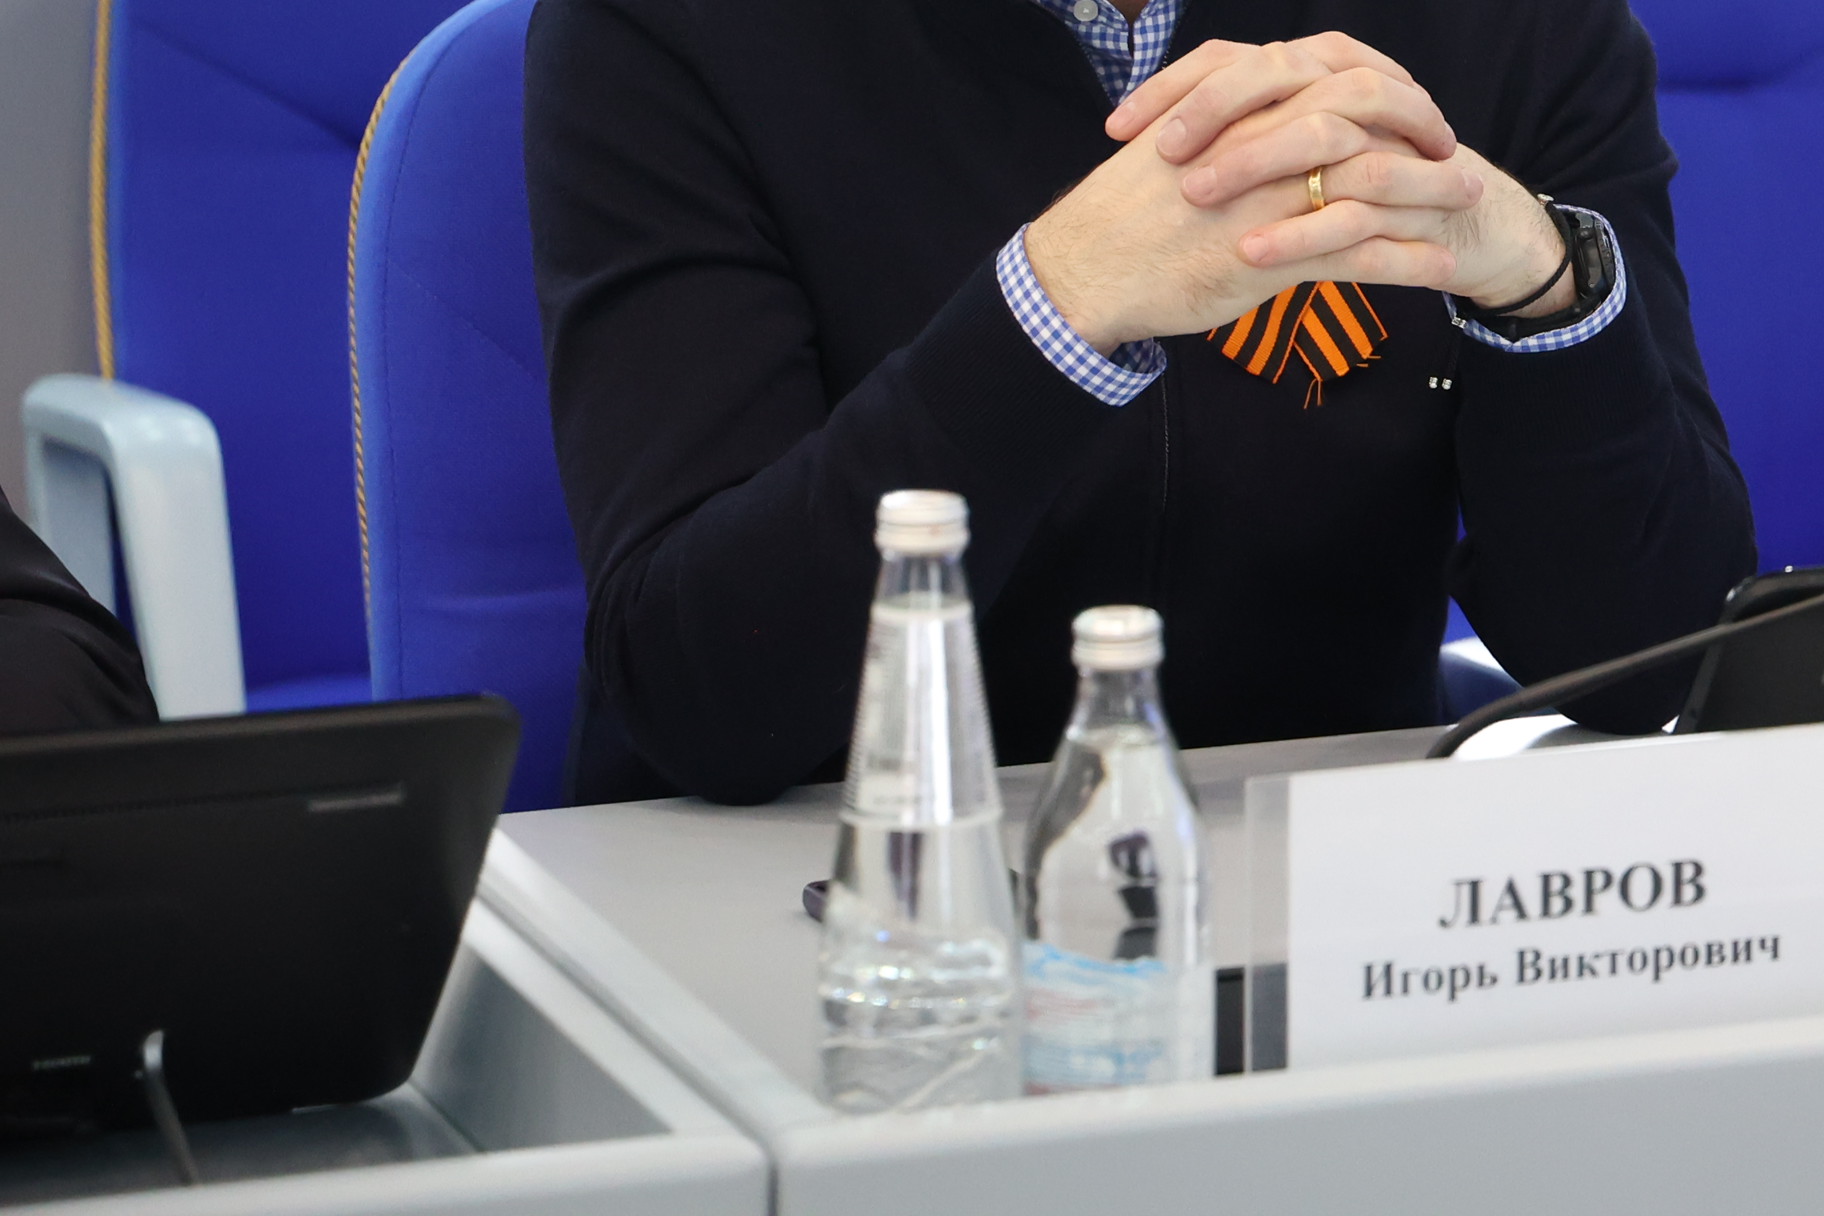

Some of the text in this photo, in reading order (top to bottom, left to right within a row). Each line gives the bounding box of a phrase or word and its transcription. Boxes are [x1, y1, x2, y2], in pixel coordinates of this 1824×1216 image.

[1438, 858, 1707, 930] ЛАВРОВ
[1361, 935, 1782, 1004] Игорь Викторович
